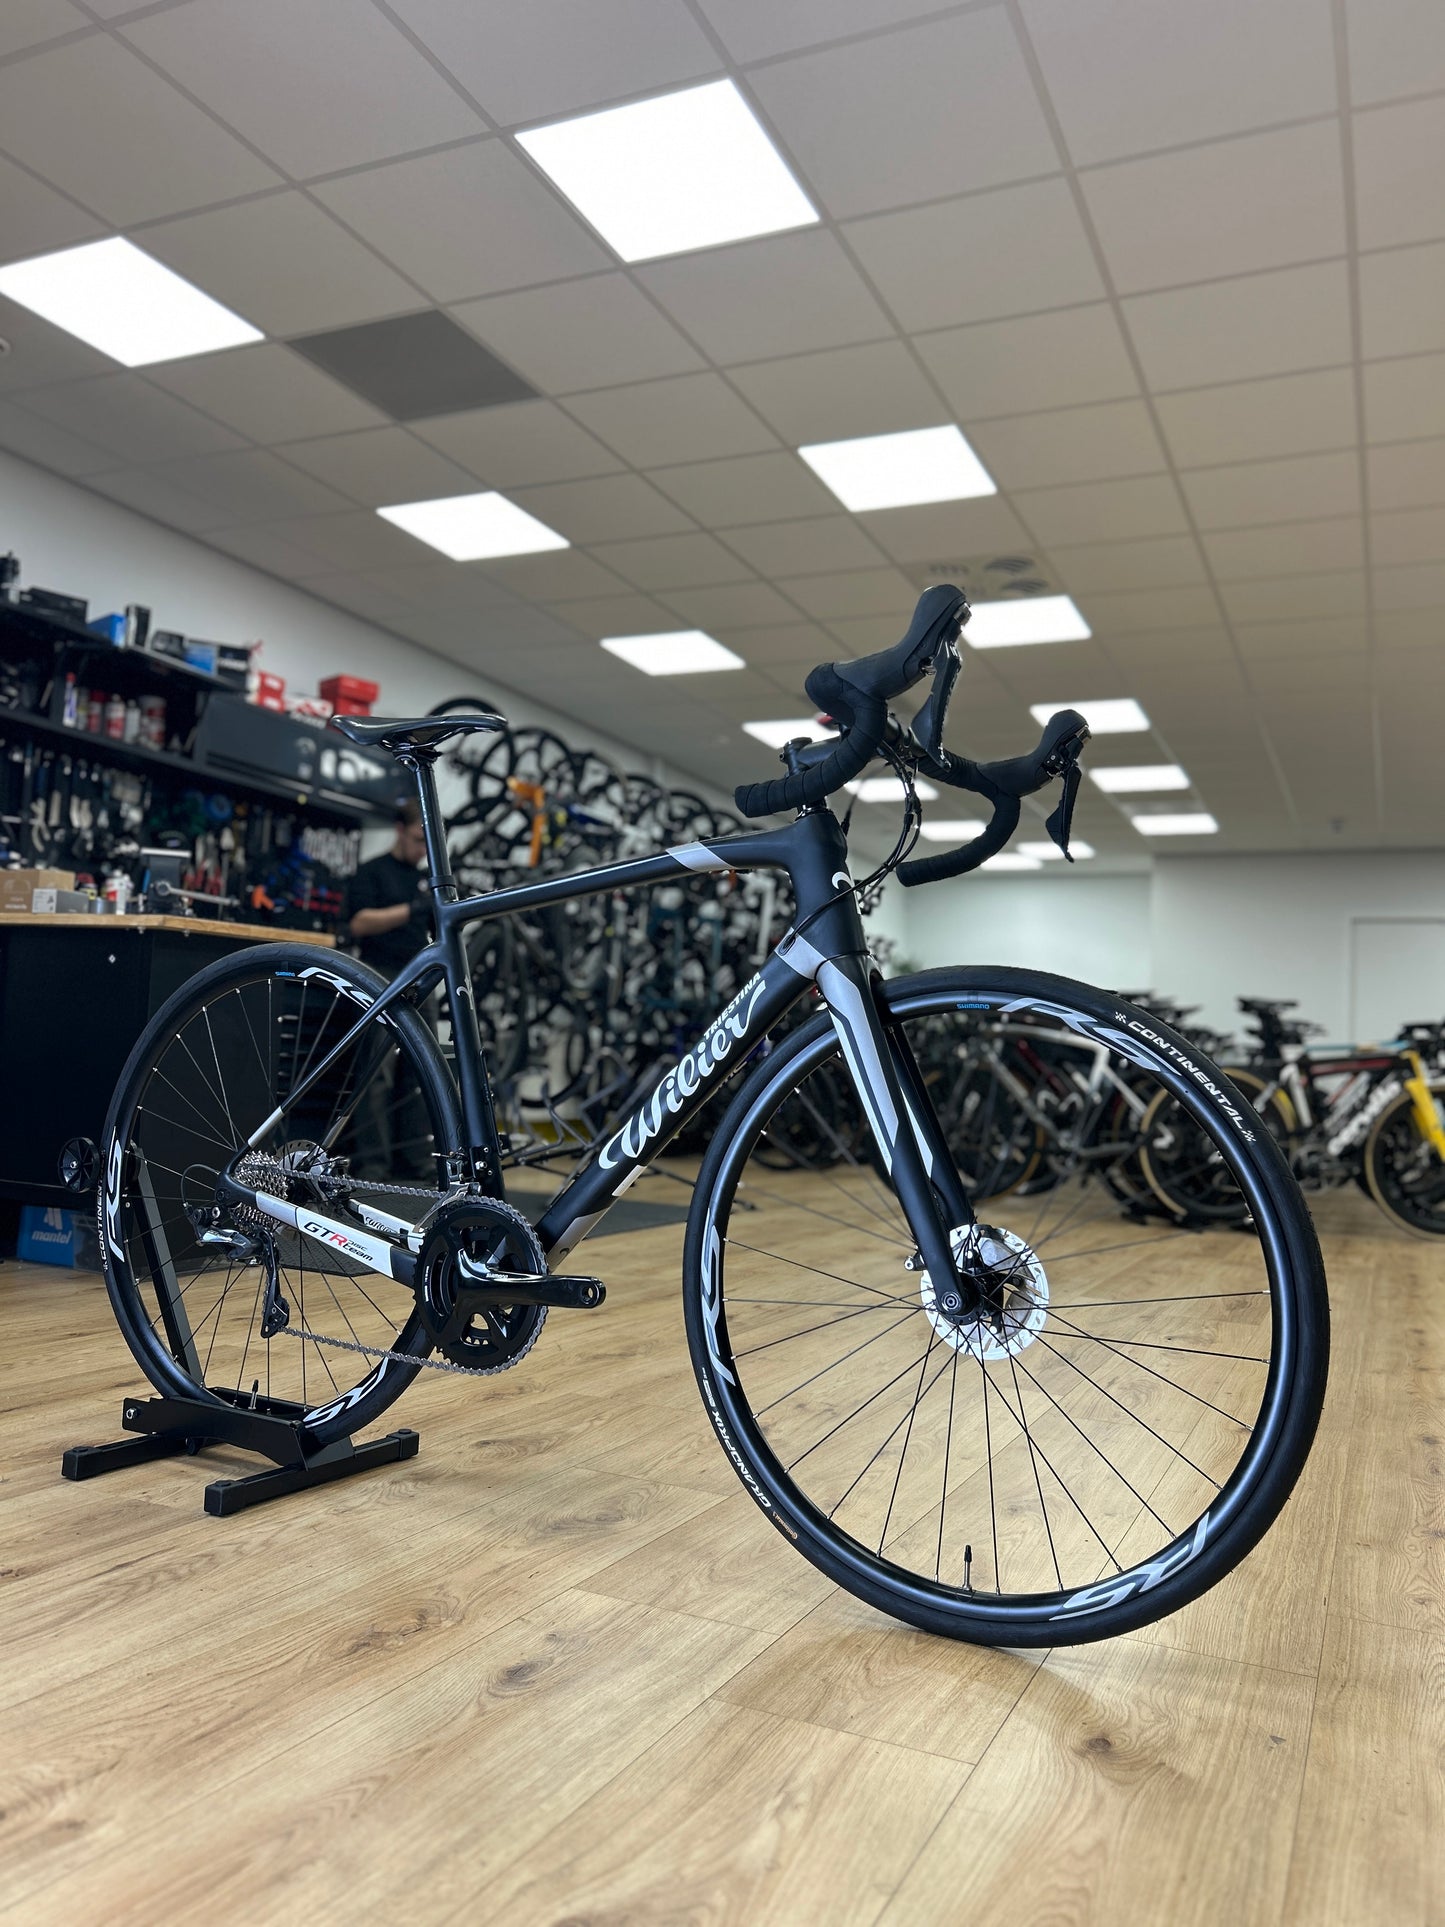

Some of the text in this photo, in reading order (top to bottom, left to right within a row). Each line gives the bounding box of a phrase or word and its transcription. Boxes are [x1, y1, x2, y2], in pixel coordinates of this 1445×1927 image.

[704, 972, 761, 1038] TRIESTINA
[599, 980, 766, 1169] Wilier
[1128, 1020, 1243, 1129] CONTINENTAL
[32, 1230, 73, 1245] mantel
[303, 1221, 348, 1247] GTR
[343, 1245, 374, 1261] team
